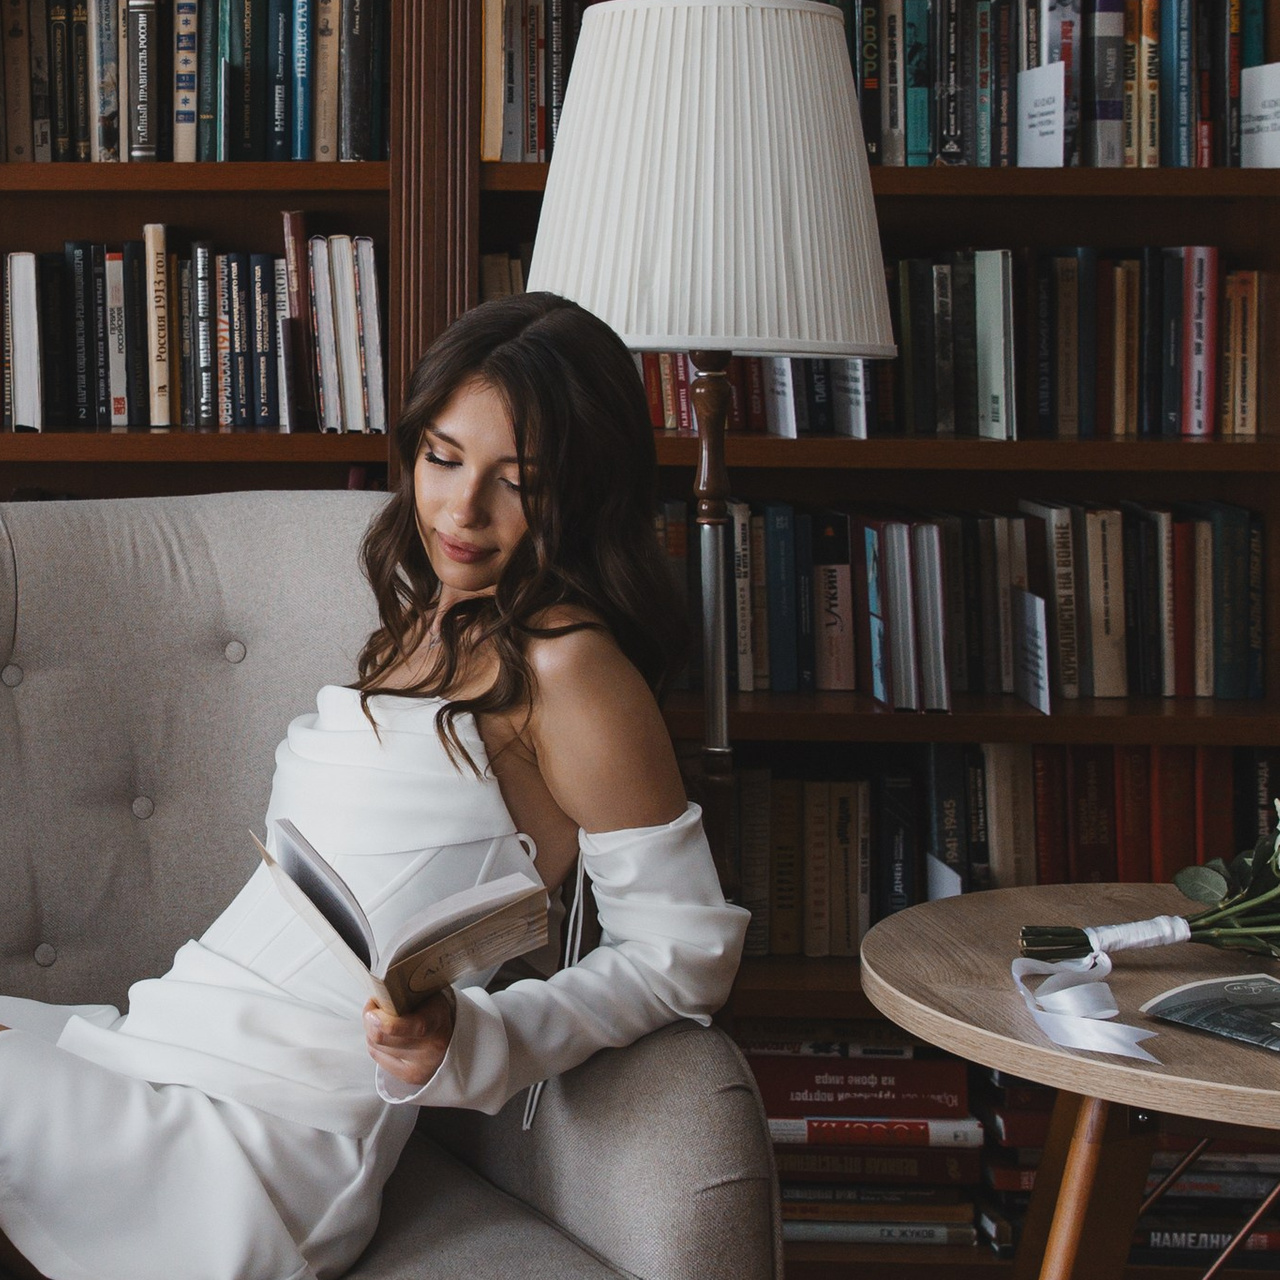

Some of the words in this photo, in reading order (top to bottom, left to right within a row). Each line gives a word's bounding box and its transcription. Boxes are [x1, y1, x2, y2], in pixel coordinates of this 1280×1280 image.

[139, 13, 148, 49] РОССИИ
[139, 49, 148, 102] ПРАВИТЕЛЬ
[1105, 47, 1117, 89] Чапаев
[1124, 44, 1136, 82] КОЛЧАК
[1147, 44, 1160, 82] КОЛЧАК
[137, 104, 149, 143] ТАЙНЫЙ
[155, 252, 165, 276] год
[154, 280, 165, 311] 1913
[109, 308, 117, 336] ПЕРВАЯ
[116, 308, 125, 355] РОССИЙСКАЯ
[155, 316, 166, 363] Россия
[216, 317, 230, 352] 1917
[1054, 522, 1071, 569] ВОЙНЕ
[1057, 572, 1072, 591] НА
[1059, 596, 1077, 686] ЖУРНАЛИСТЫ
[944, 799, 959, 864] 1941-1945
